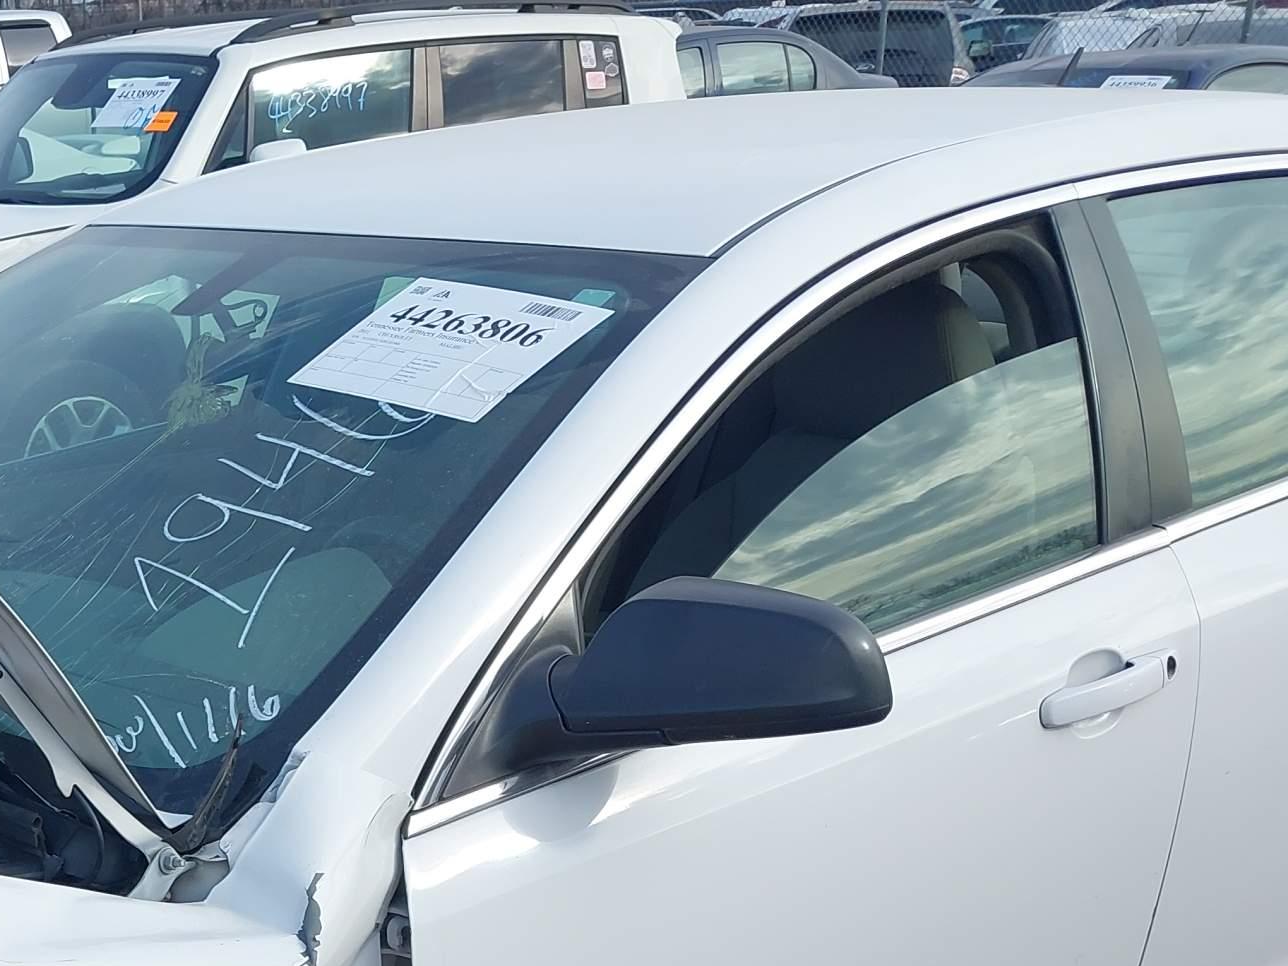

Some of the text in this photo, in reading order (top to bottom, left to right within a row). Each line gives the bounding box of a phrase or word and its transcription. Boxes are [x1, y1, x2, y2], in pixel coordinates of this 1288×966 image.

[366, 320, 403, 333] Tennessee
[403, 326, 435, 338] Farmers
[435, 332, 476, 345] Insurance
[390, 304, 555, 347] 44263806
